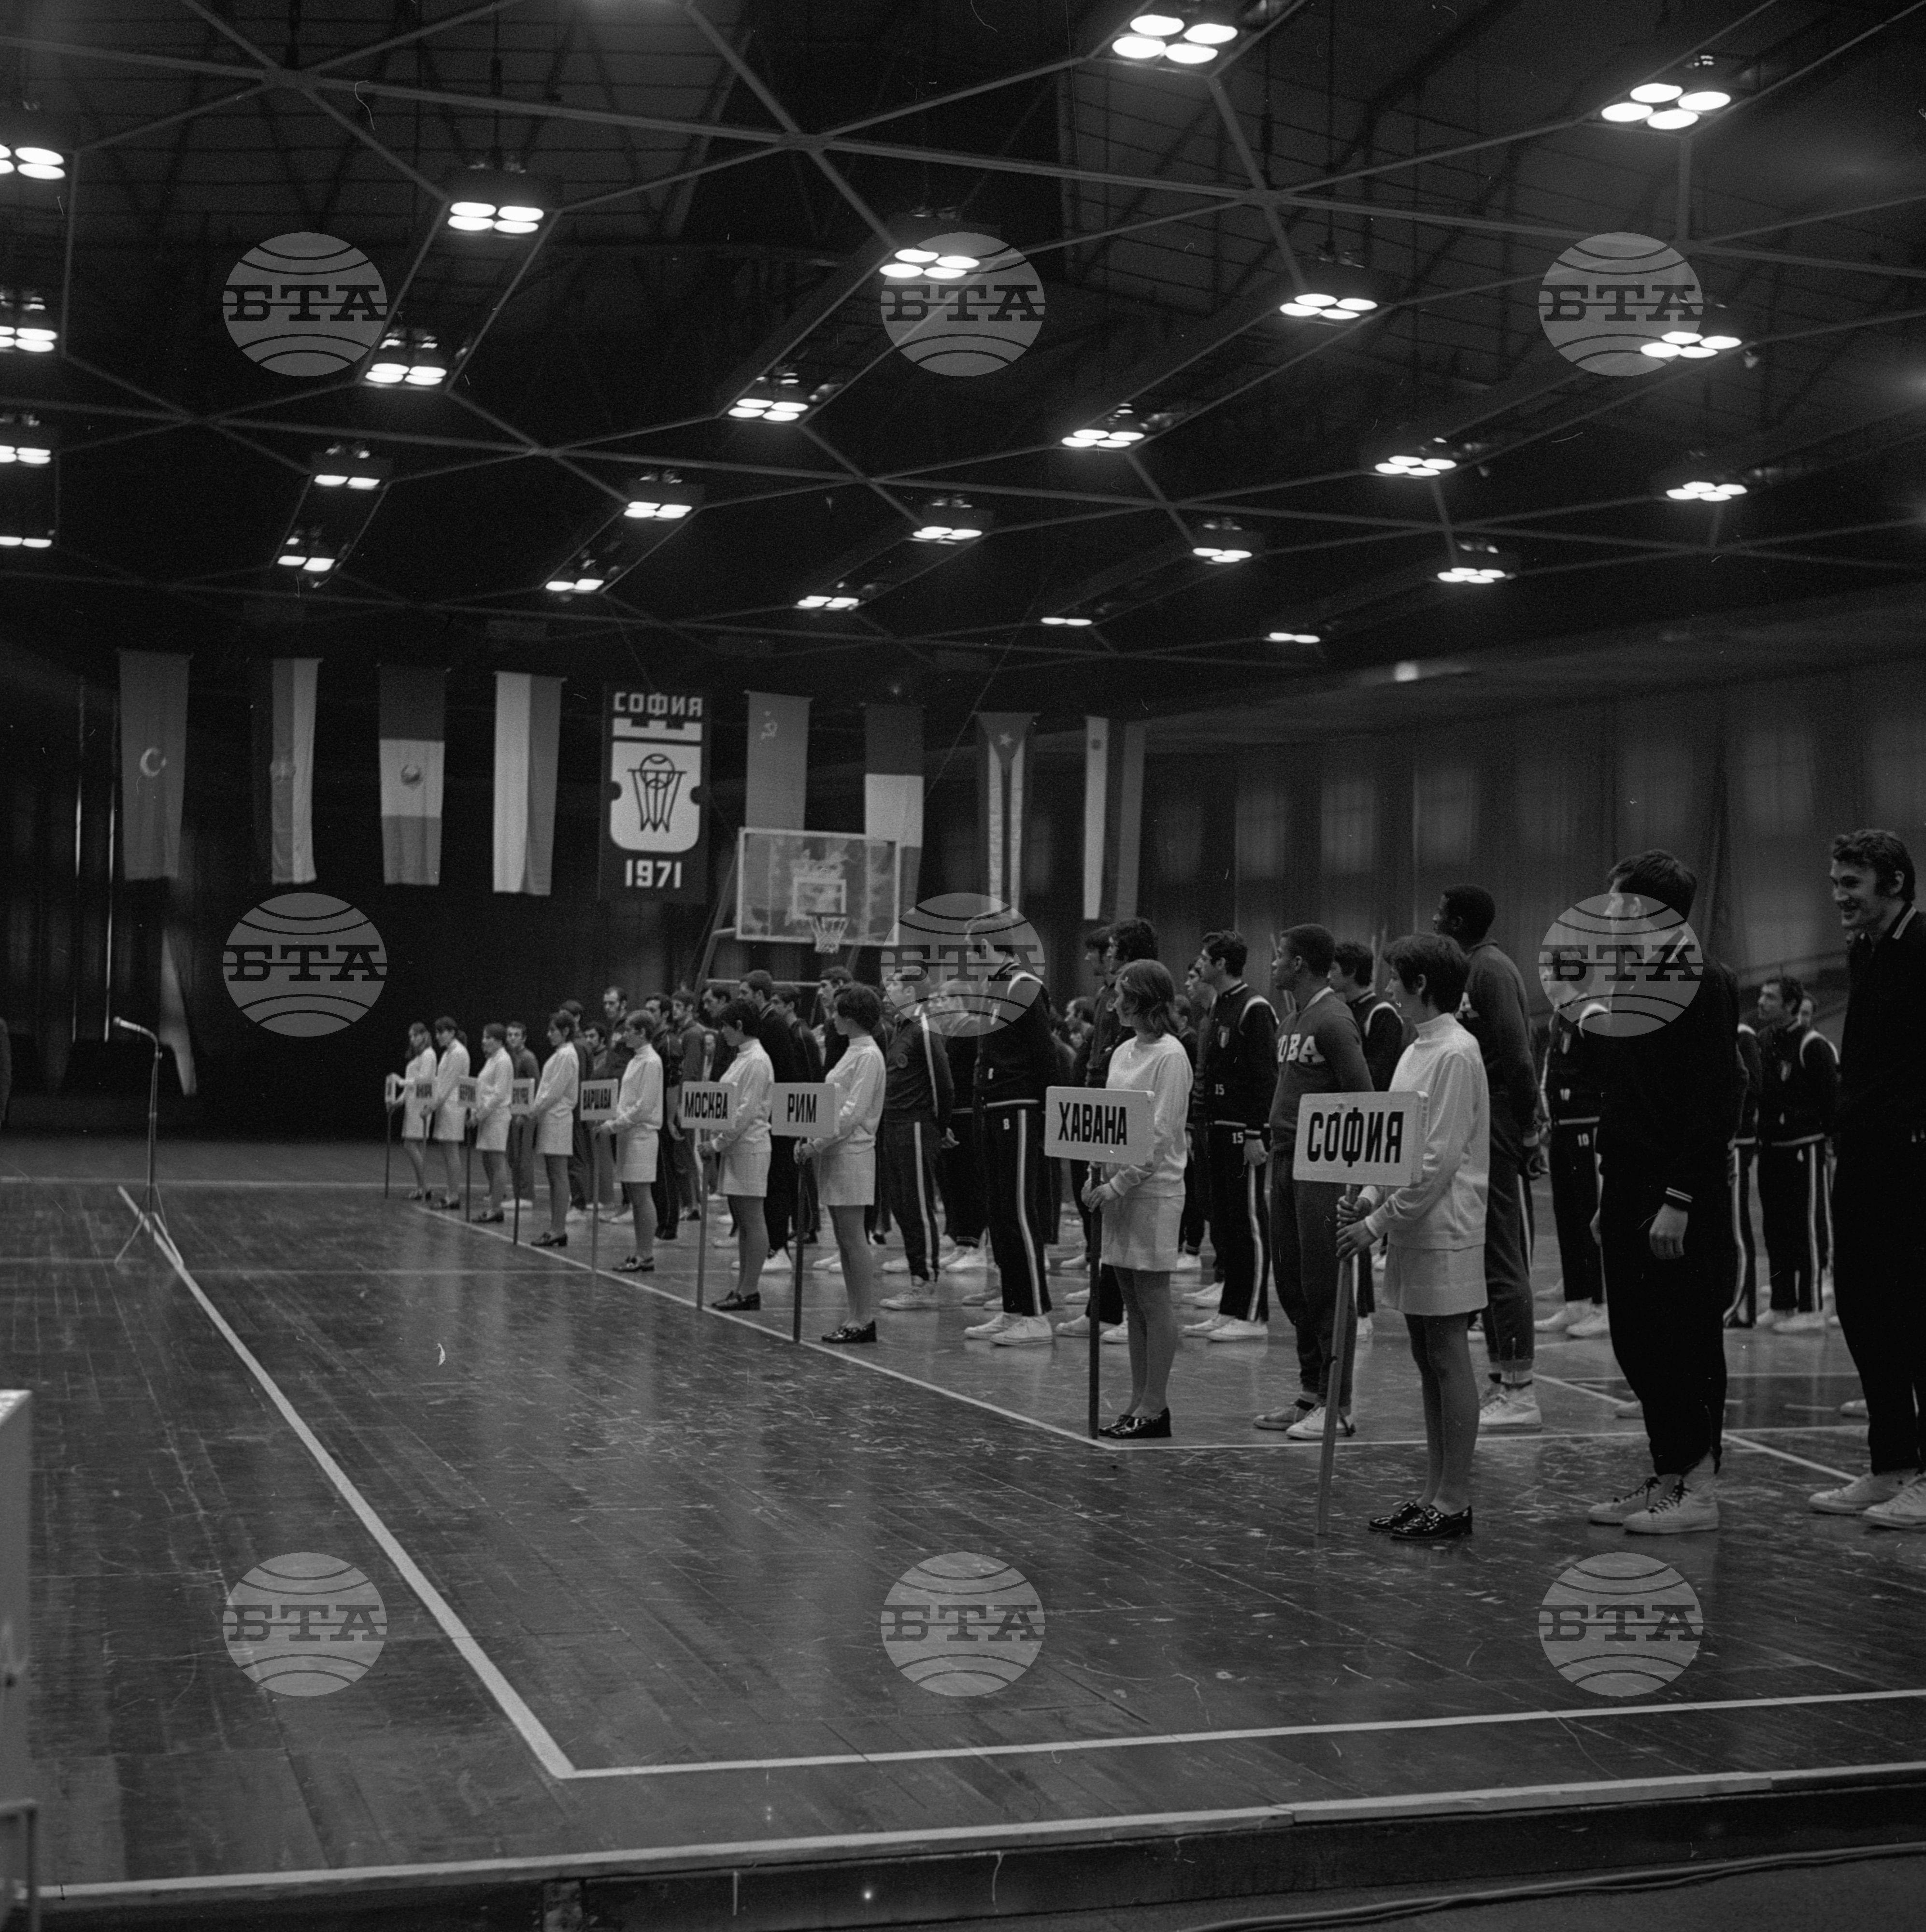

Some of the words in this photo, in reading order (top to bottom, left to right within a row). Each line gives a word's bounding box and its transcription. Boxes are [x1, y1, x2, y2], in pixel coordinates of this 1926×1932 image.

[613, 692, 703, 717] СОФИЯ
[625, 859, 682, 889] 1971
[1278, 1033, 1326, 1063] UBA
[1215, 1084, 1225, 1095] 15
[684, 1091, 728, 1119] МОСКВА
[787, 1093, 817, 1123] РИМ
[1003, 1118, 1010, 1130] 8
[1058, 1101, 1127, 1145] ХАВАНА
[1307, 1107, 1404, 1167] СОФИЯ
[1232, 1132, 1244, 1144] 15
[1577, 1133, 1589, 1147] 10
